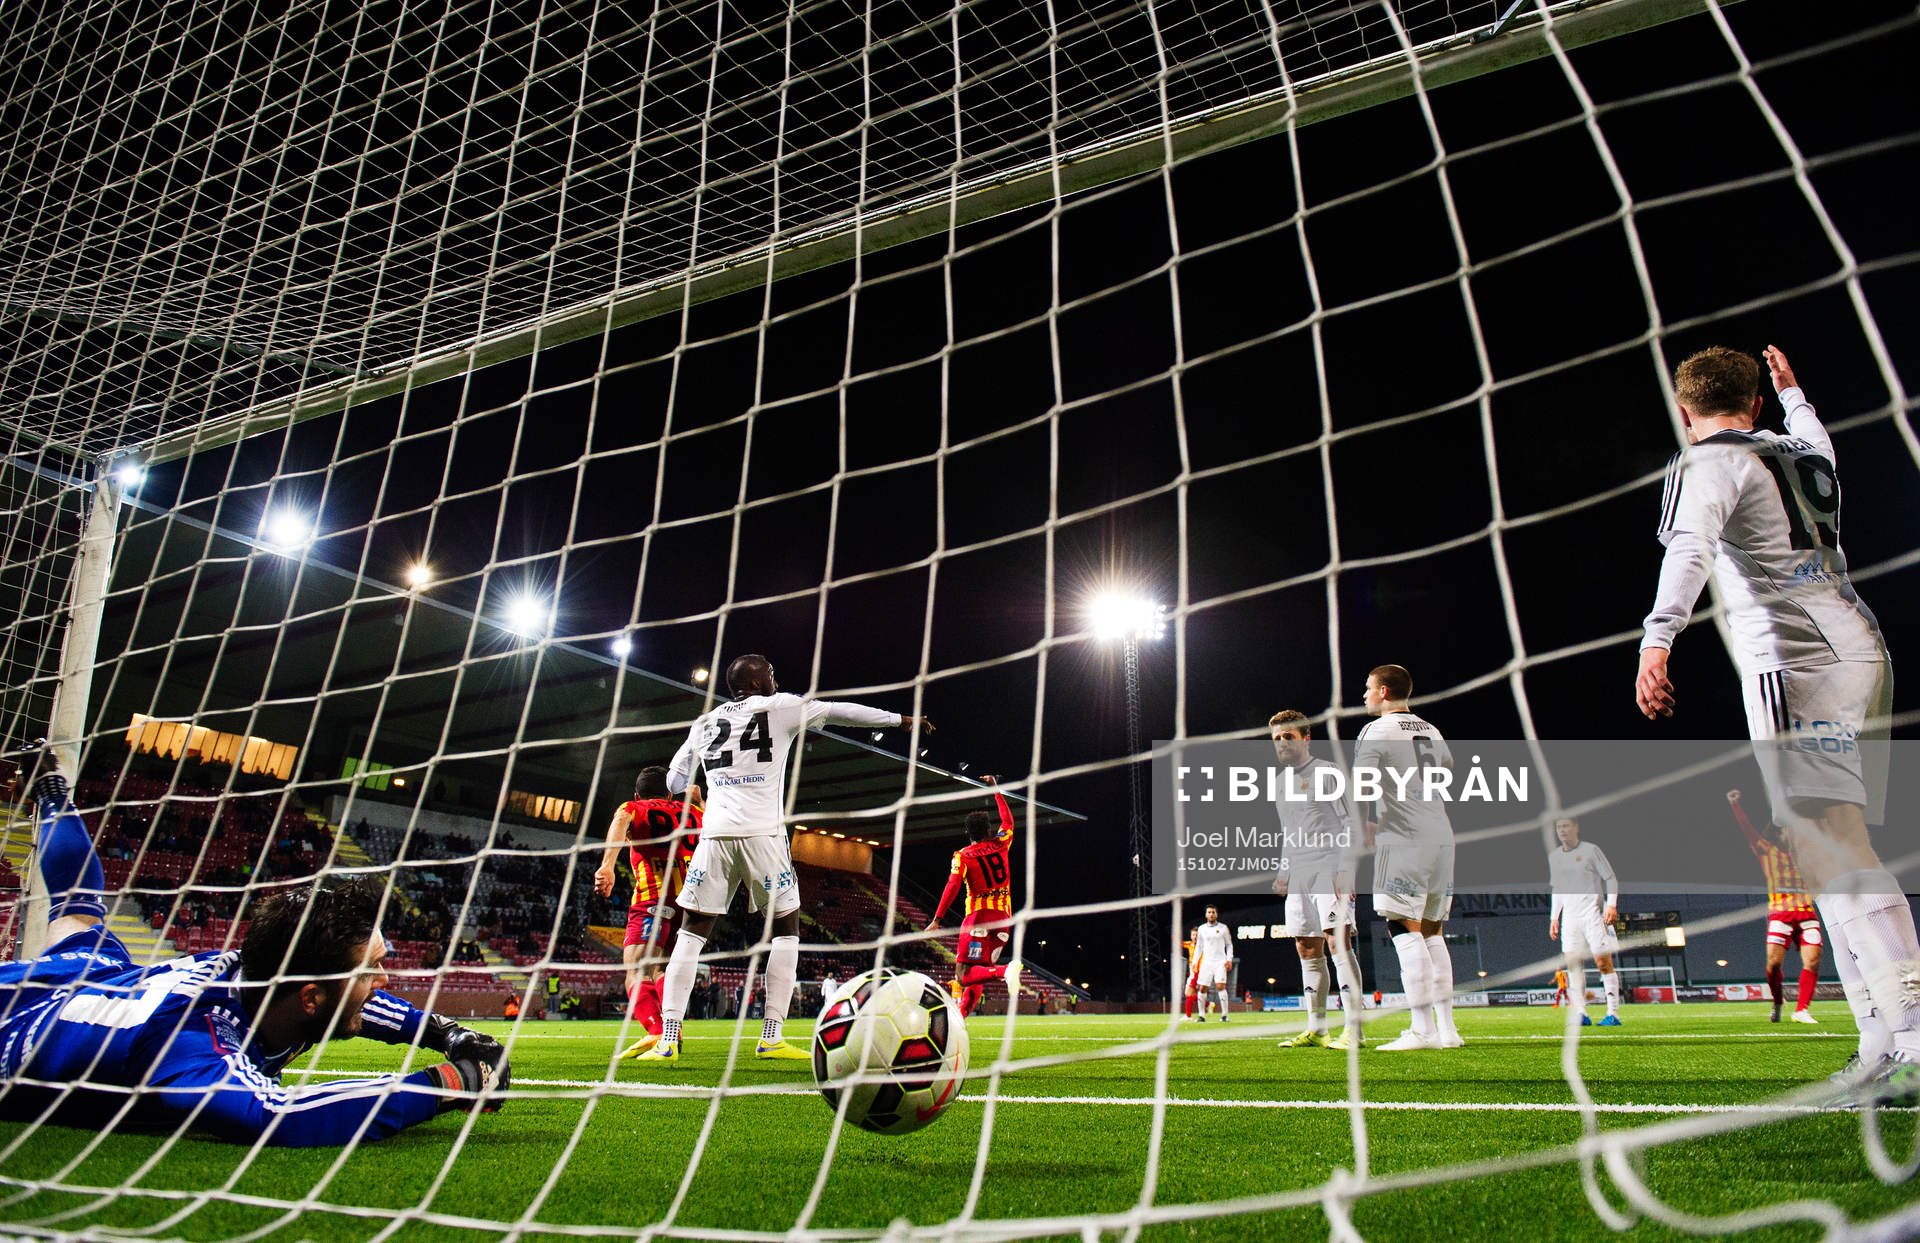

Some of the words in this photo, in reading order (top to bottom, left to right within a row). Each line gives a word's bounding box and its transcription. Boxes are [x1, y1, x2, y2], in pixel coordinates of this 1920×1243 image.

[1759, 455, 1841, 551] 19
[703, 711, 774, 772] 24
[1412, 735, 1437, 785] 6
[1799, 737, 1856, 755] SOF
[977, 852, 1007, 889] 18
